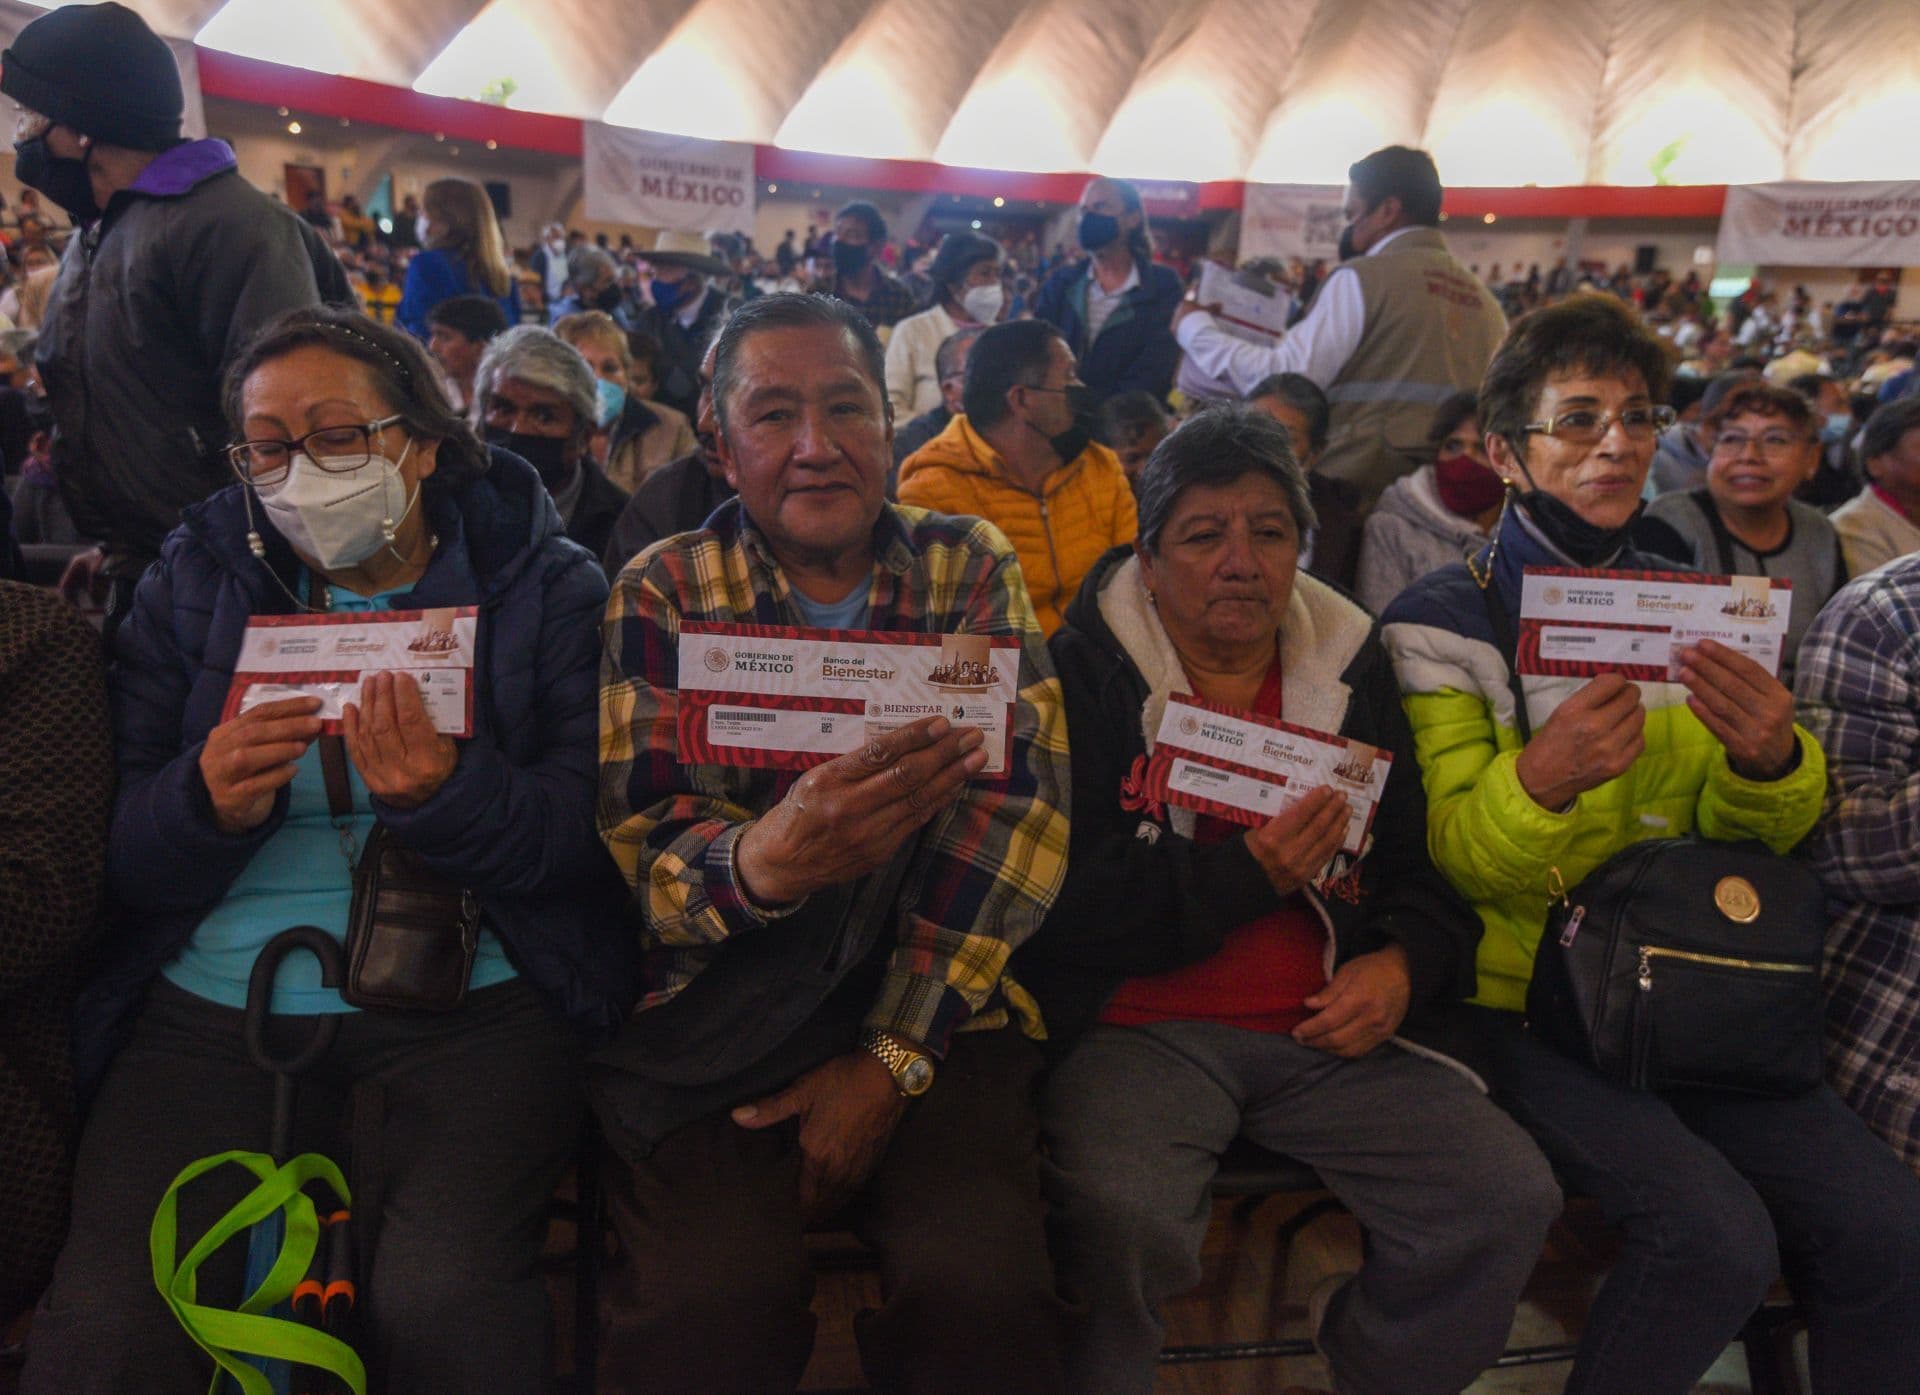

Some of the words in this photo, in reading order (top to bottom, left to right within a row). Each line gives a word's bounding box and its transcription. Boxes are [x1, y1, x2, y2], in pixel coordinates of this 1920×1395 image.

[639, 157, 721, 180] GOBIERNO
[725, 168, 743, 181] DE
[640, 173, 744, 207] MÉXICO
[1781, 211, 1918, 238] MÉXICO
[1567, 595, 1614, 606] MÉXICO
[1637, 599, 1694, 611] Bienestar
[735, 651, 780, 663] GOBIERNO
[782, 654, 794, 662] DE
[823, 656, 850, 665] Banco
[851, 657, 865, 666] del
[735, 659, 794, 674] MÉXICO
[822, 665, 895, 680] Bienestar
[884, 704, 943, 714] BIENESTAR
[1201, 729, 1243, 746] MÉXICO
[1262, 745, 1314, 766] Bienestar
